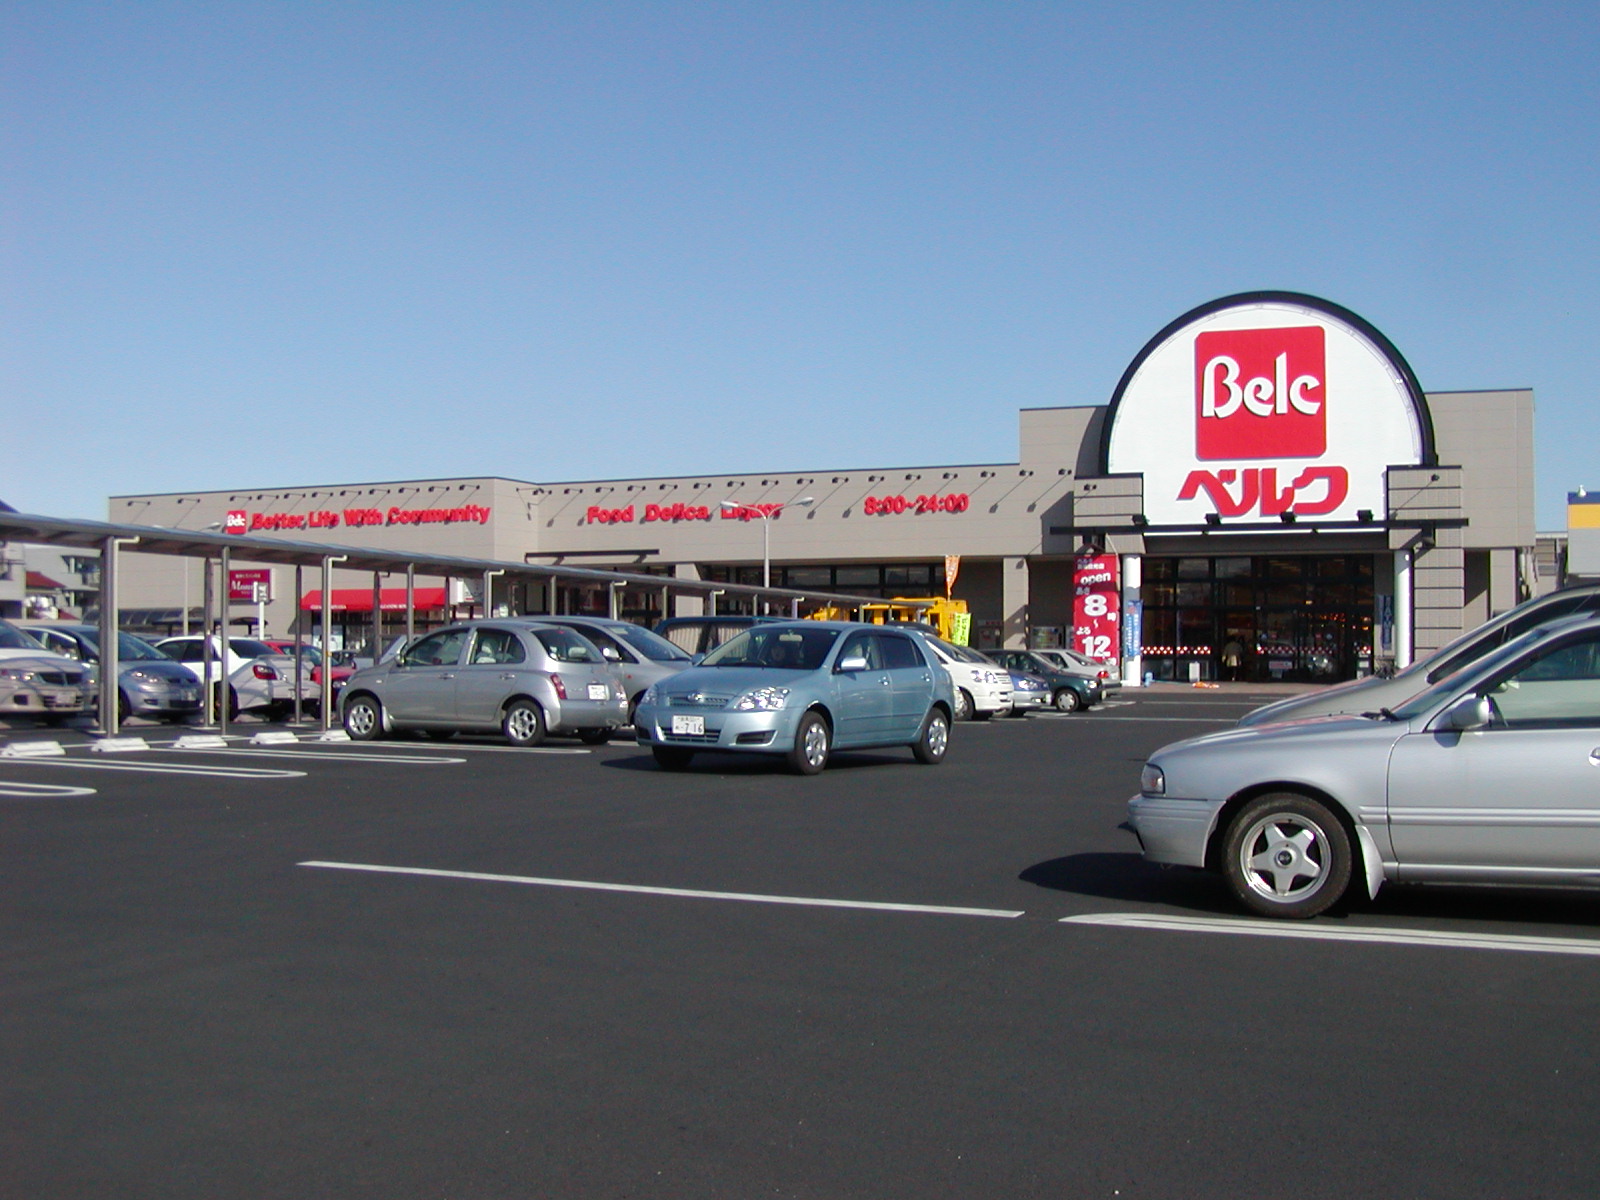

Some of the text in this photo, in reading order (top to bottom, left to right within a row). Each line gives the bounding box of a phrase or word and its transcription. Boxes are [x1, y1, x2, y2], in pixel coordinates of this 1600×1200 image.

[1202, 351, 1321, 419] Belc
[1176, 466, 1349, 517] ベルク
[251, 506, 491, 530] Better Life With Community
[587, 505, 634, 524] Food
[645, 503, 709, 522] Delica
[1080, 572, 1111, 585] open
